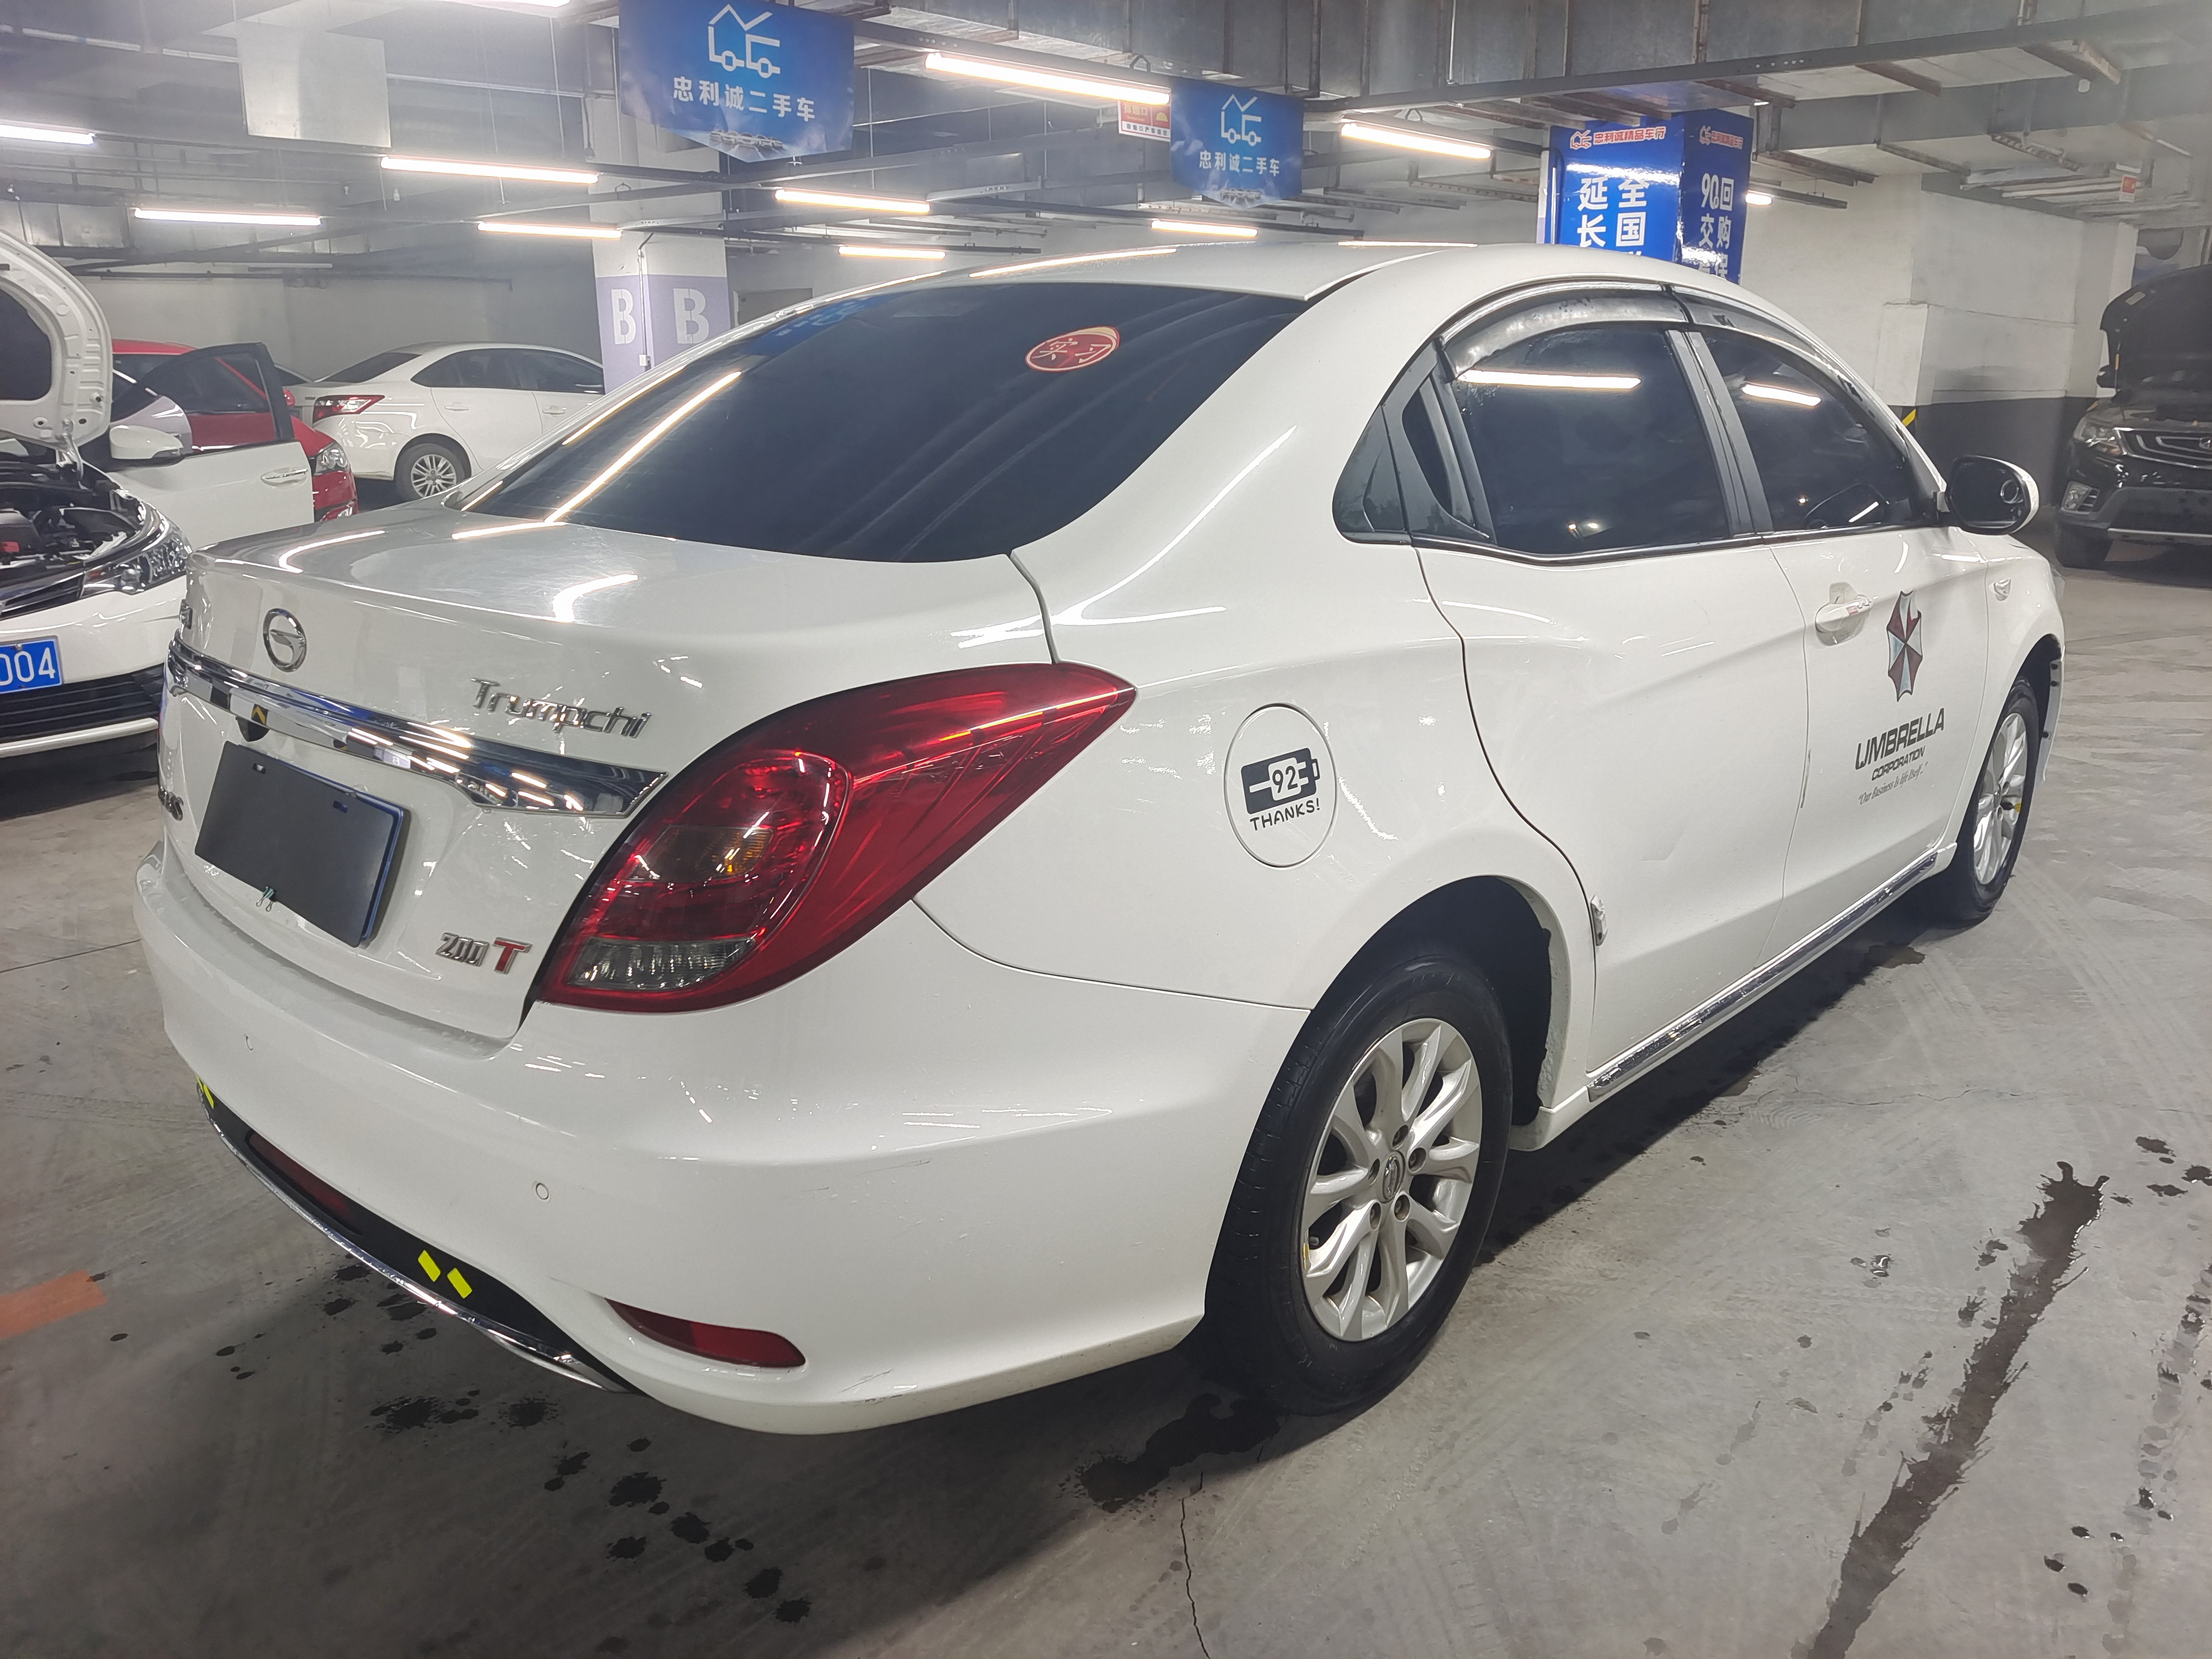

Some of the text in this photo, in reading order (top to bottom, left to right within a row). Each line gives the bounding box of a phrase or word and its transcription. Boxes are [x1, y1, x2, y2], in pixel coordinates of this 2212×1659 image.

[673, 76, 816, 122] 忠利诚二手车
[1199, 150, 1280, 176] 忠利诚二手车
[611, 289, 637, 345] B
[672, 288, 709, 345] B
[471, 677, 653, 739] Trumpchi
[1855, 707, 1944, 770] UMBRELLA
[1272, 765, 1298, 794] 92
[1871, 745, 1926, 781] CORPORATION
[1249, 797, 1321, 831] THANKS!
